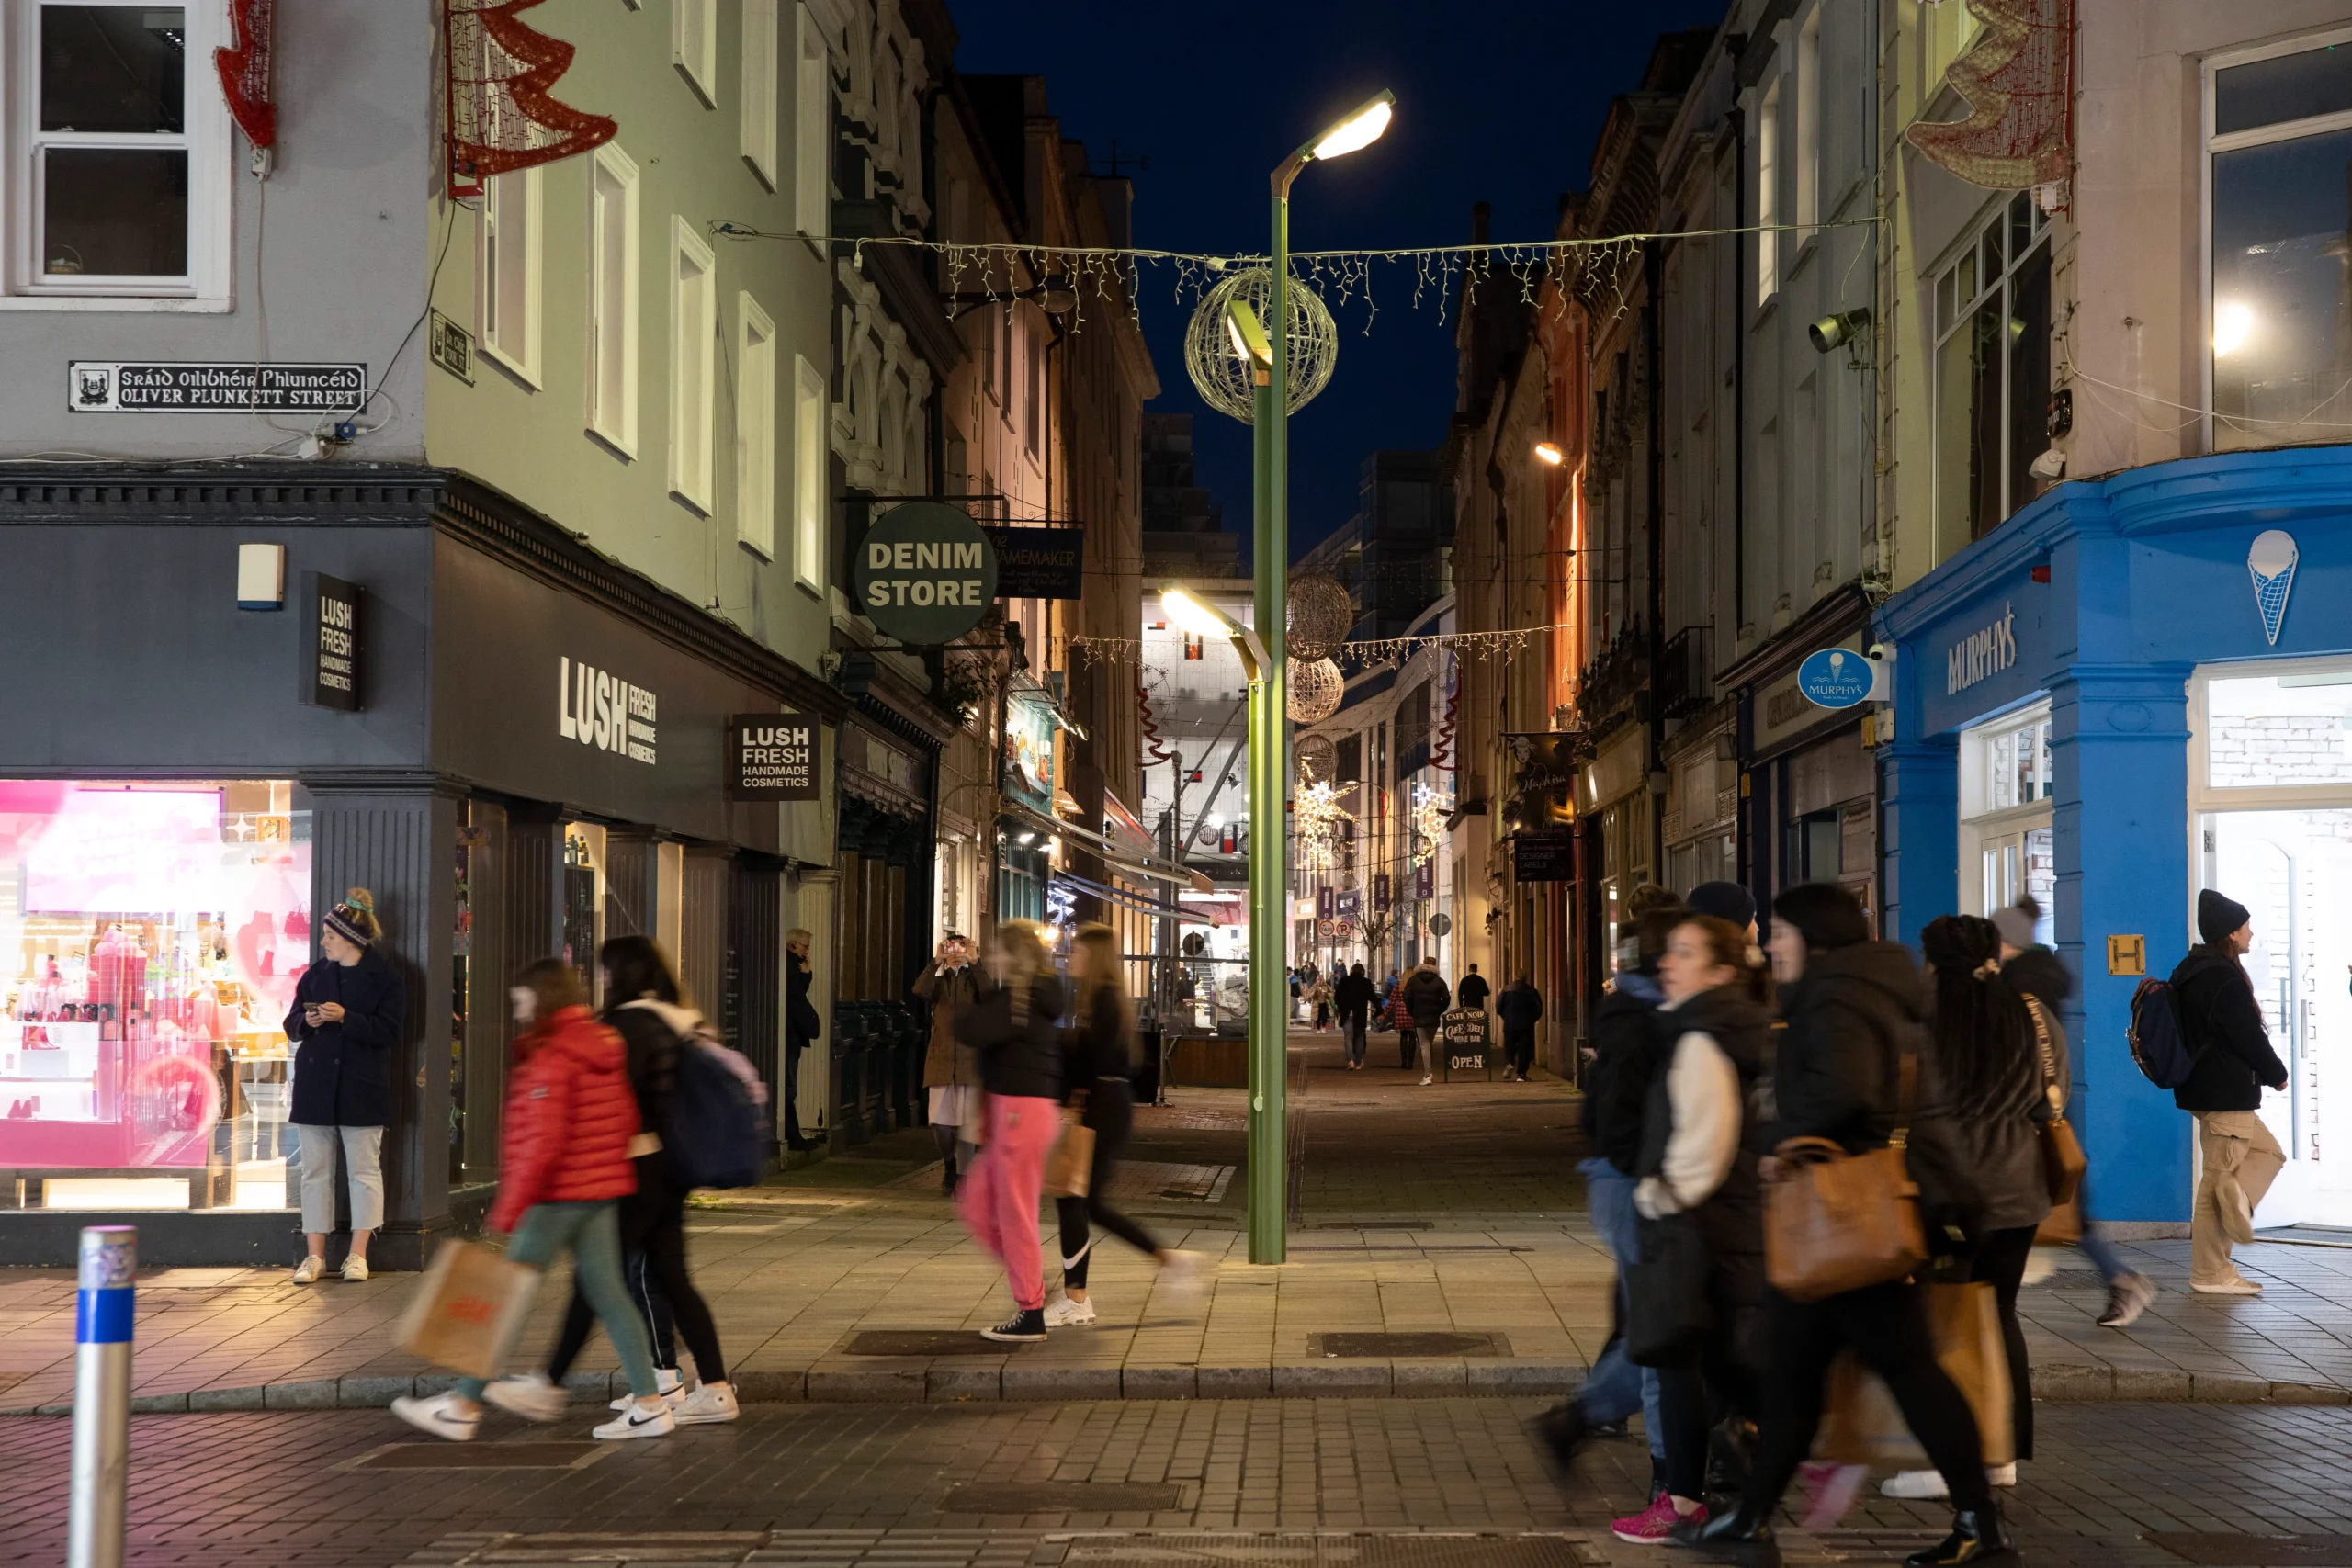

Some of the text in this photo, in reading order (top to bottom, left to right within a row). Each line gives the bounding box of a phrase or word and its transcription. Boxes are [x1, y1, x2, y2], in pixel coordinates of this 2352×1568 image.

[120, 389, 356, 405] OLIVER PLUNKETT STREET
[868, 542, 983, 569] DENIM
[867, 580, 982, 606] STORE
[321, 596, 353, 631] LUSH
[320, 626, 352, 657] FRESH
[1947, 600, 2017, 696] MURPHY'S
[320, 653, 352, 674] HANDMADE
[319, 671, 352, 692] COSMETICS
[1808, 684, 1863, 695] MURPHY'S
[559, 655, 628, 756] LUSH
[628, 683, 656, 723] FRESH
[628, 718, 656, 744] HANDMADE
[742, 728, 809, 746] LUSH
[628, 740, 656, 765] COSMETICS
[742, 748, 809, 764] FRESH
[742, 766, 809, 776] HANDMADE
[742, 777, 809, 787] COSMETICS
[1519, 852, 1555, 861] DESIGNER
[1519, 861, 1547, 869] LABELS
[1452, 1055, 1483, 1069] OPEN
[2041, 1043, 2056, 1077] RIVER
